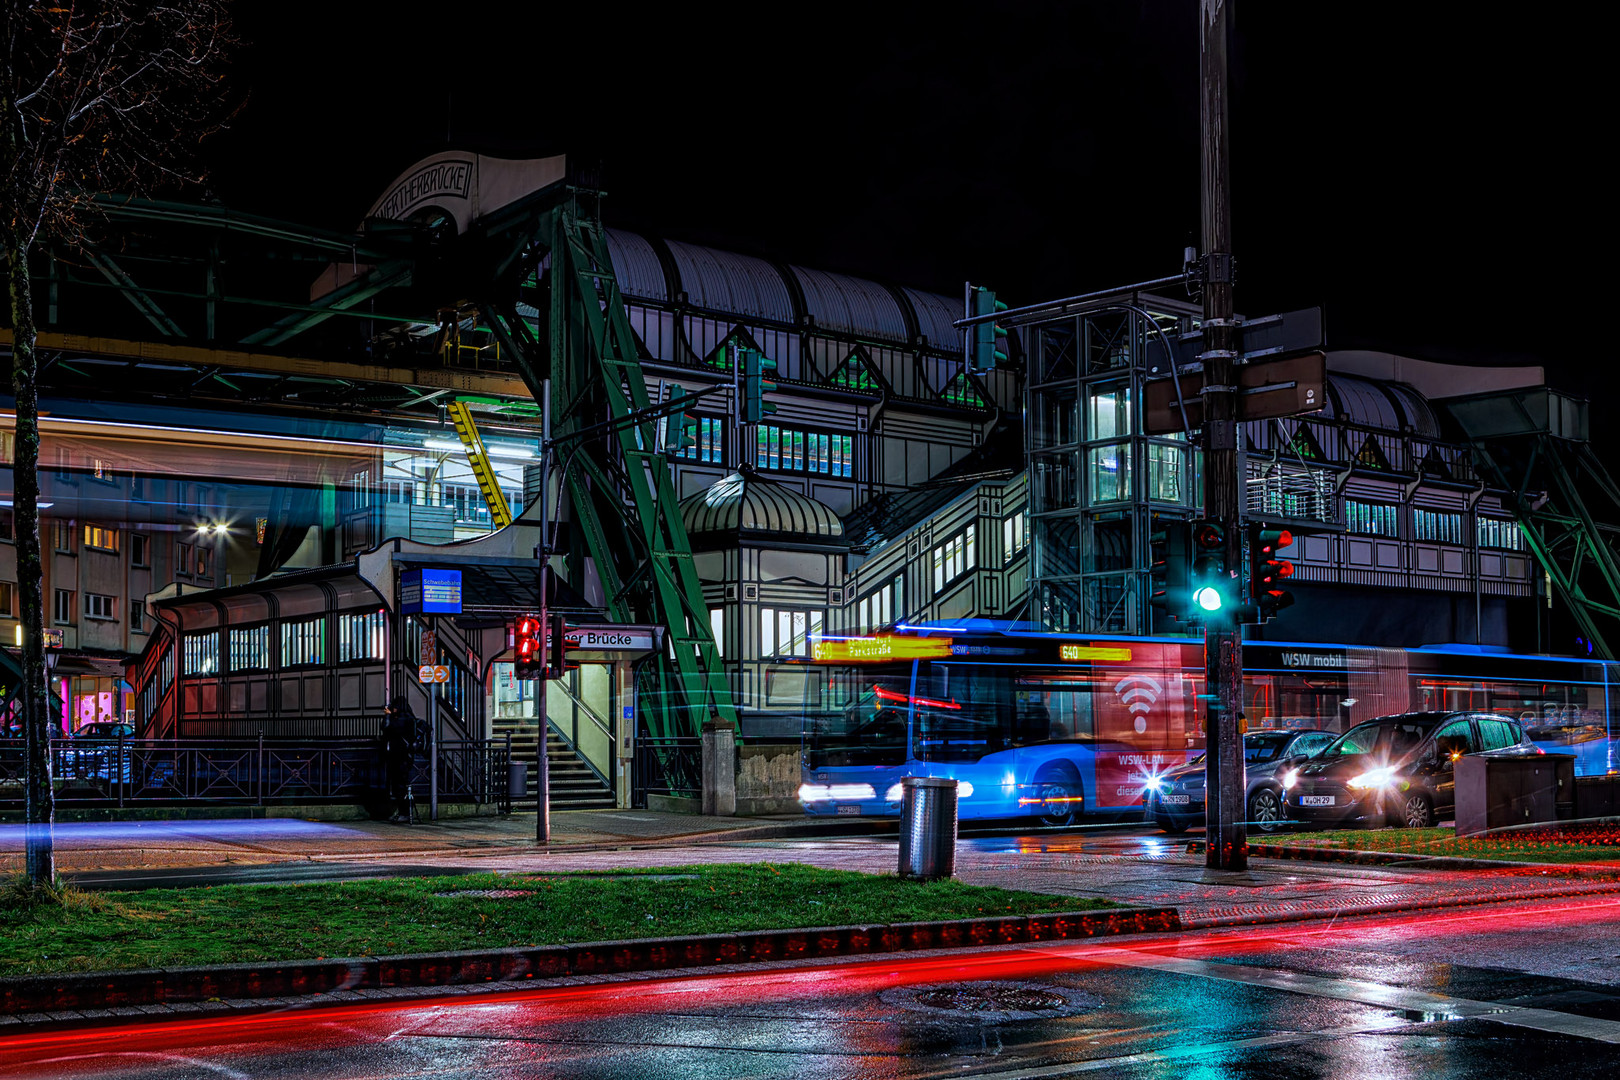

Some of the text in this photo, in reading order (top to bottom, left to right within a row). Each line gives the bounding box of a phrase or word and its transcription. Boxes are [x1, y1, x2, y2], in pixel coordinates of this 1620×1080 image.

[587, 632, 631, 645] Brücke
[814, 642, 832, 660] 640
[849, 643, 892, 657] Parkstraße
[1062, 647, 1077, 659] 640
[1281, 652, 1342, 667] WSW mobil
[1118, 755, 1164, 765] WSW-LAN
